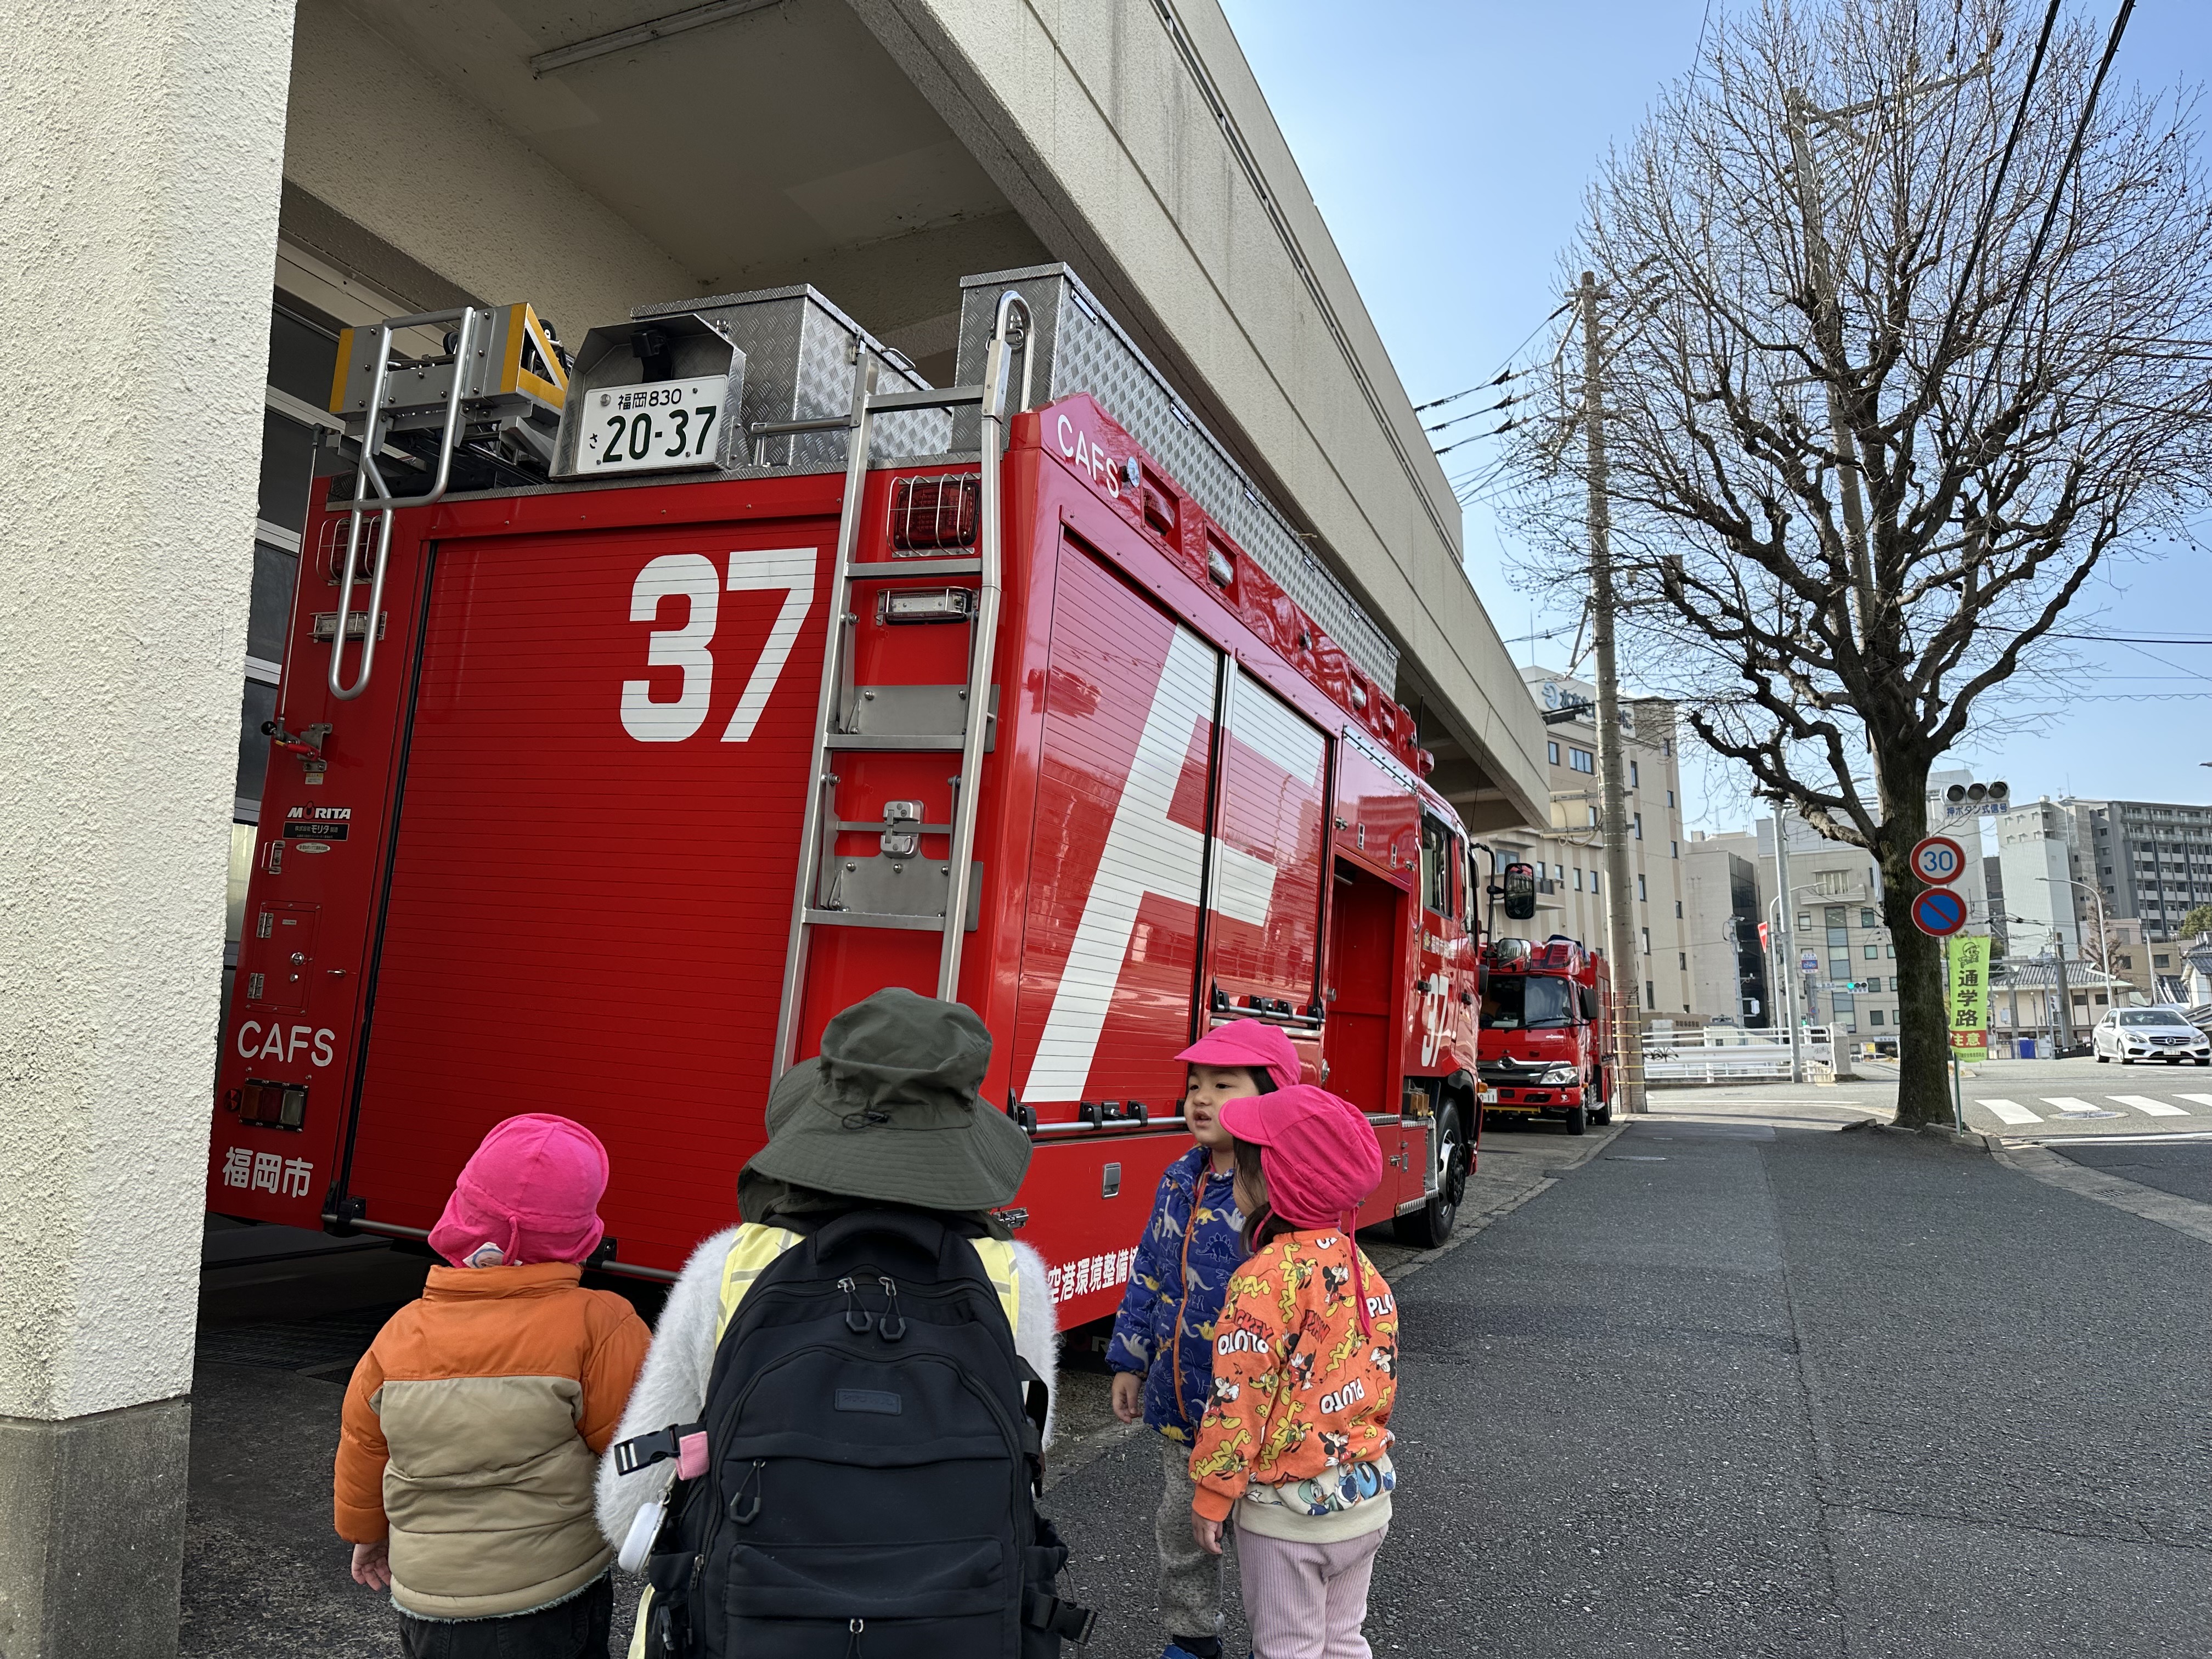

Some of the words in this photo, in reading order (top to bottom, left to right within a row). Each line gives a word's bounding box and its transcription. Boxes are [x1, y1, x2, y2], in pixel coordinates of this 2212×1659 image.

[602, 405, 717, 462] 20-37
[1057, 414, 1119, 499] CAFS
[620, 548, 818, 743] 37
[287, 802, 352, 820] MORITA
[1946, 803, 2008, 817] 押ボタン式信号
[1923, 850, 1953, 872] 30
[1421, 972, 1449, 1068] 37
[1955, 969, 1979, 1027] 通学路
[238, 1020, 336, 1067] CAFS
[222, 1146, 313, 1198] 福岡市
[1217, 1328, 1269, 1356] PLUTO
[1319, 1376, 1365, 1414] PLUTO
